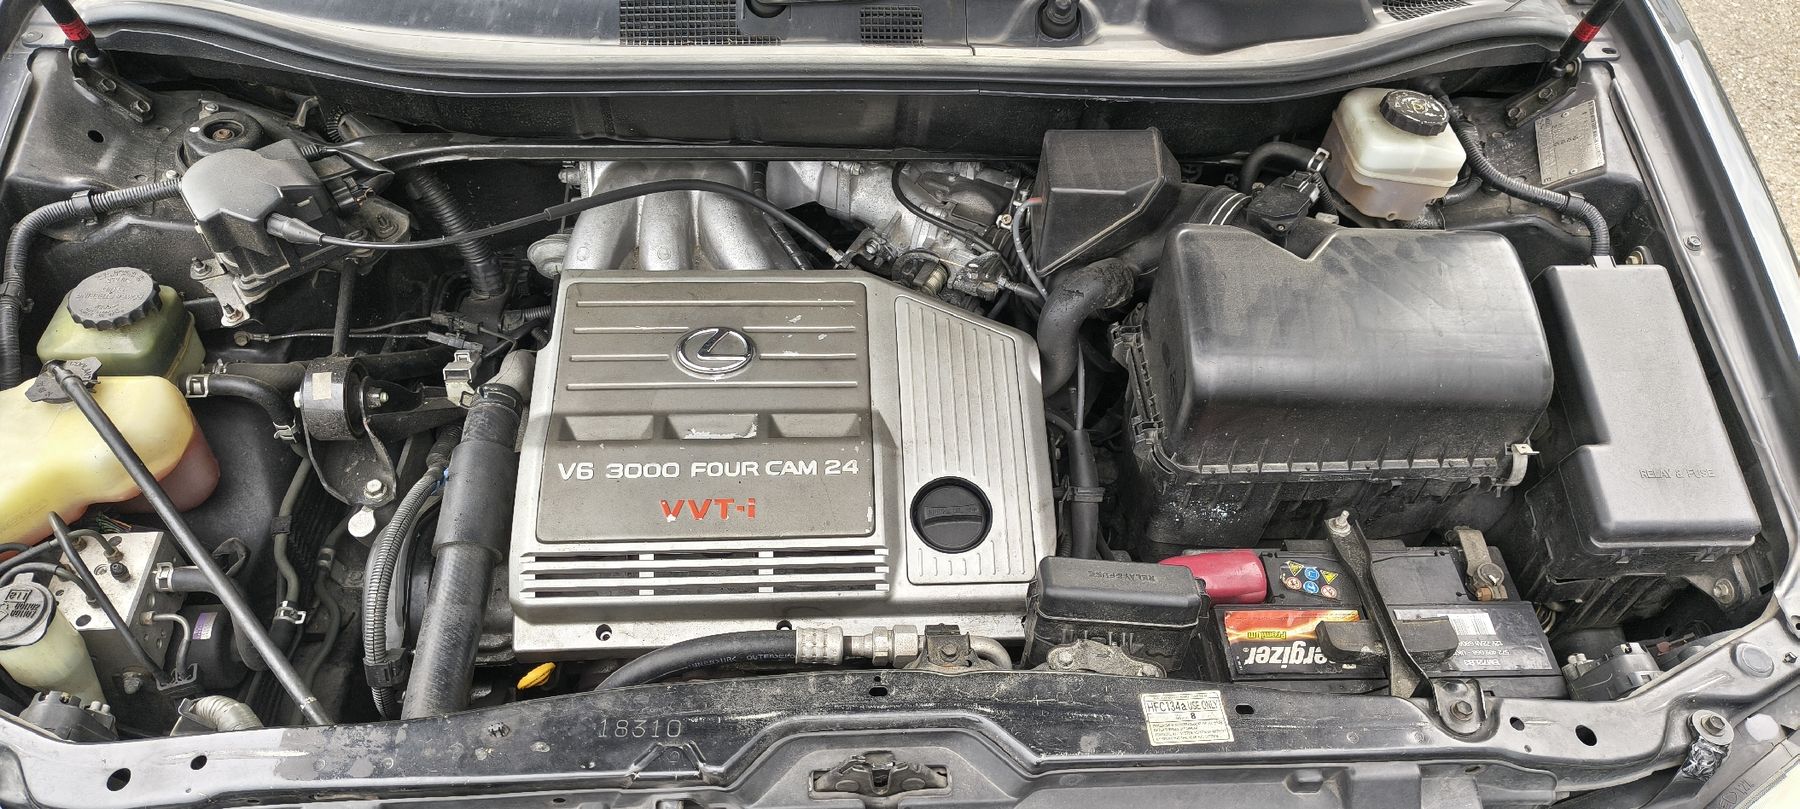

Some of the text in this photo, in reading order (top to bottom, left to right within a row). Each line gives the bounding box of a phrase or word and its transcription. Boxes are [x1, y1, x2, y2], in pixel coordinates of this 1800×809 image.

[558, 459, 859, 480] V6 3000 FOUR CAM 24
[1638, 468, 1716, 479] RELAY & FUSE
[660, 498, 757, 521] VVT-i
[1247, 631, 1287, 641] Premium
[1244, 641, 1337, 669] ergizer
[1146, 698, 1218, 713] HFC134a USE ONLY
[598, 718, 682, 738] 18310
